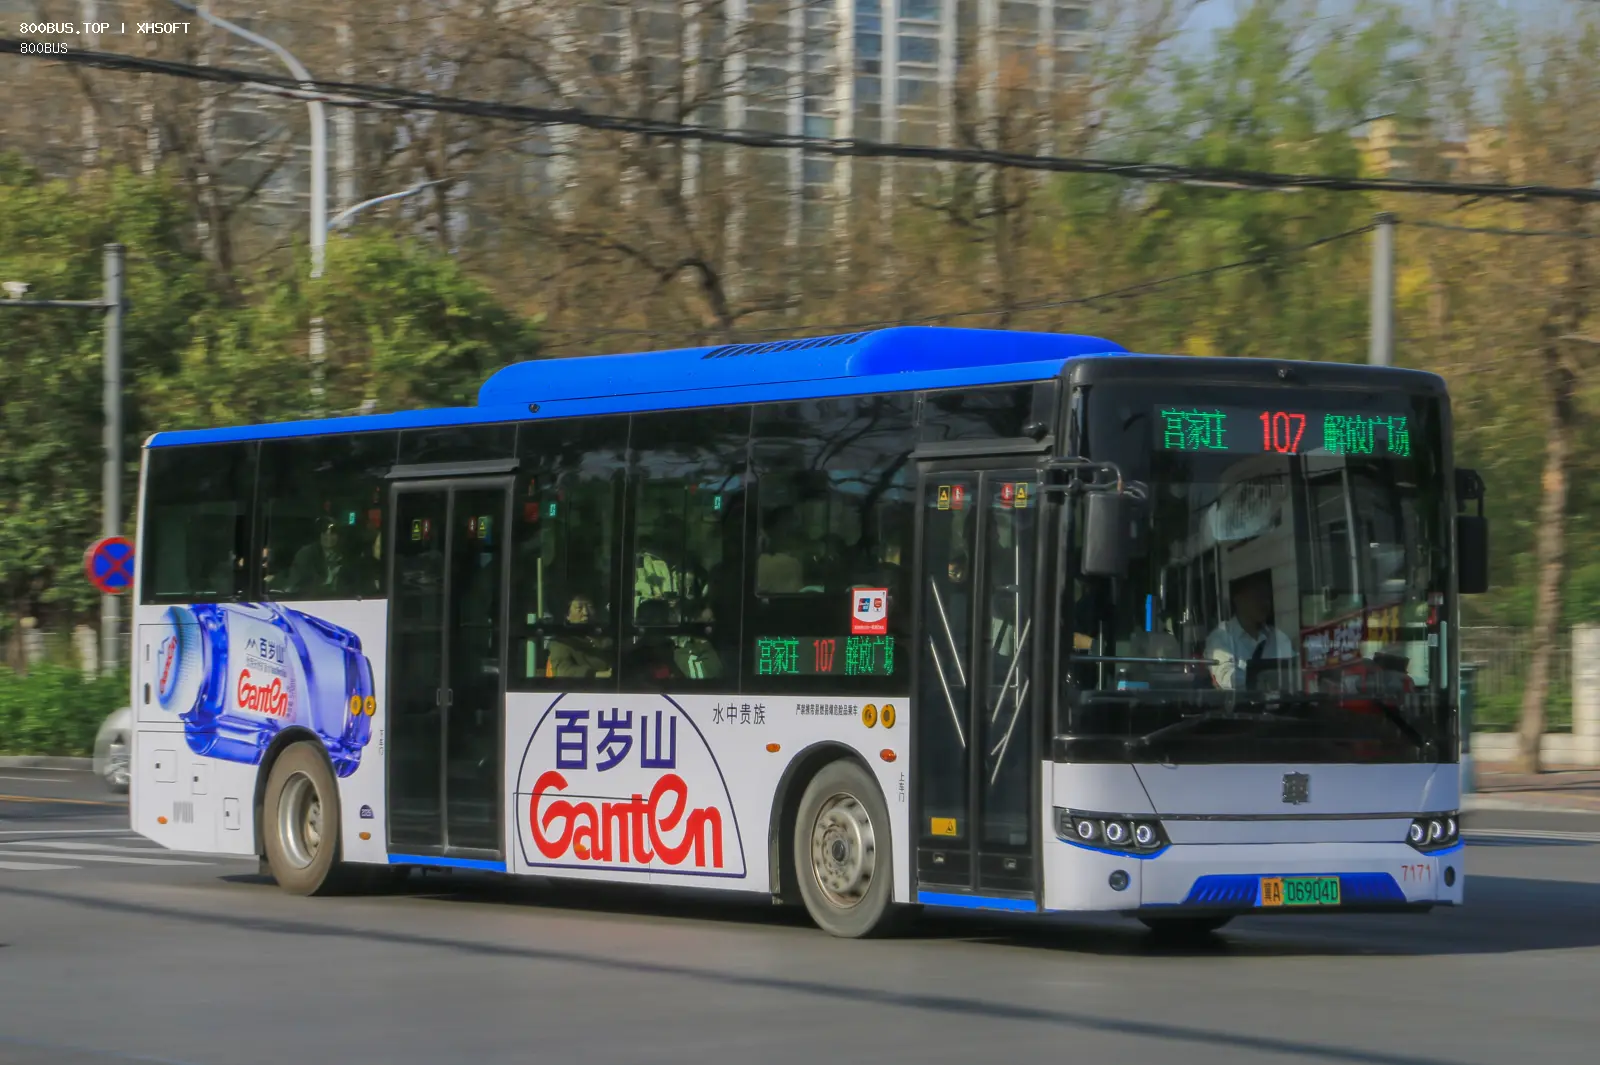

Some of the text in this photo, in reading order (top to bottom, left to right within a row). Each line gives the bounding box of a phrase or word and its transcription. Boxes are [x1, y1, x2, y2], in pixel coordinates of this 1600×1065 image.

[1259, 411, 1307, 453] 107
[1323, 413, 1411, 457] 解放广场
[813, 639, 836, 672] 107
[844, 636, 894, 676] 解放广场
[237, 669, 289, 718] Ganten
[712, 702, 766, 725] 水中贵族
[554, 707, 677, 772] 百岁山
[529, 770, 724, 868] Ganten
[1400, 863, 1431, 883] 7171
